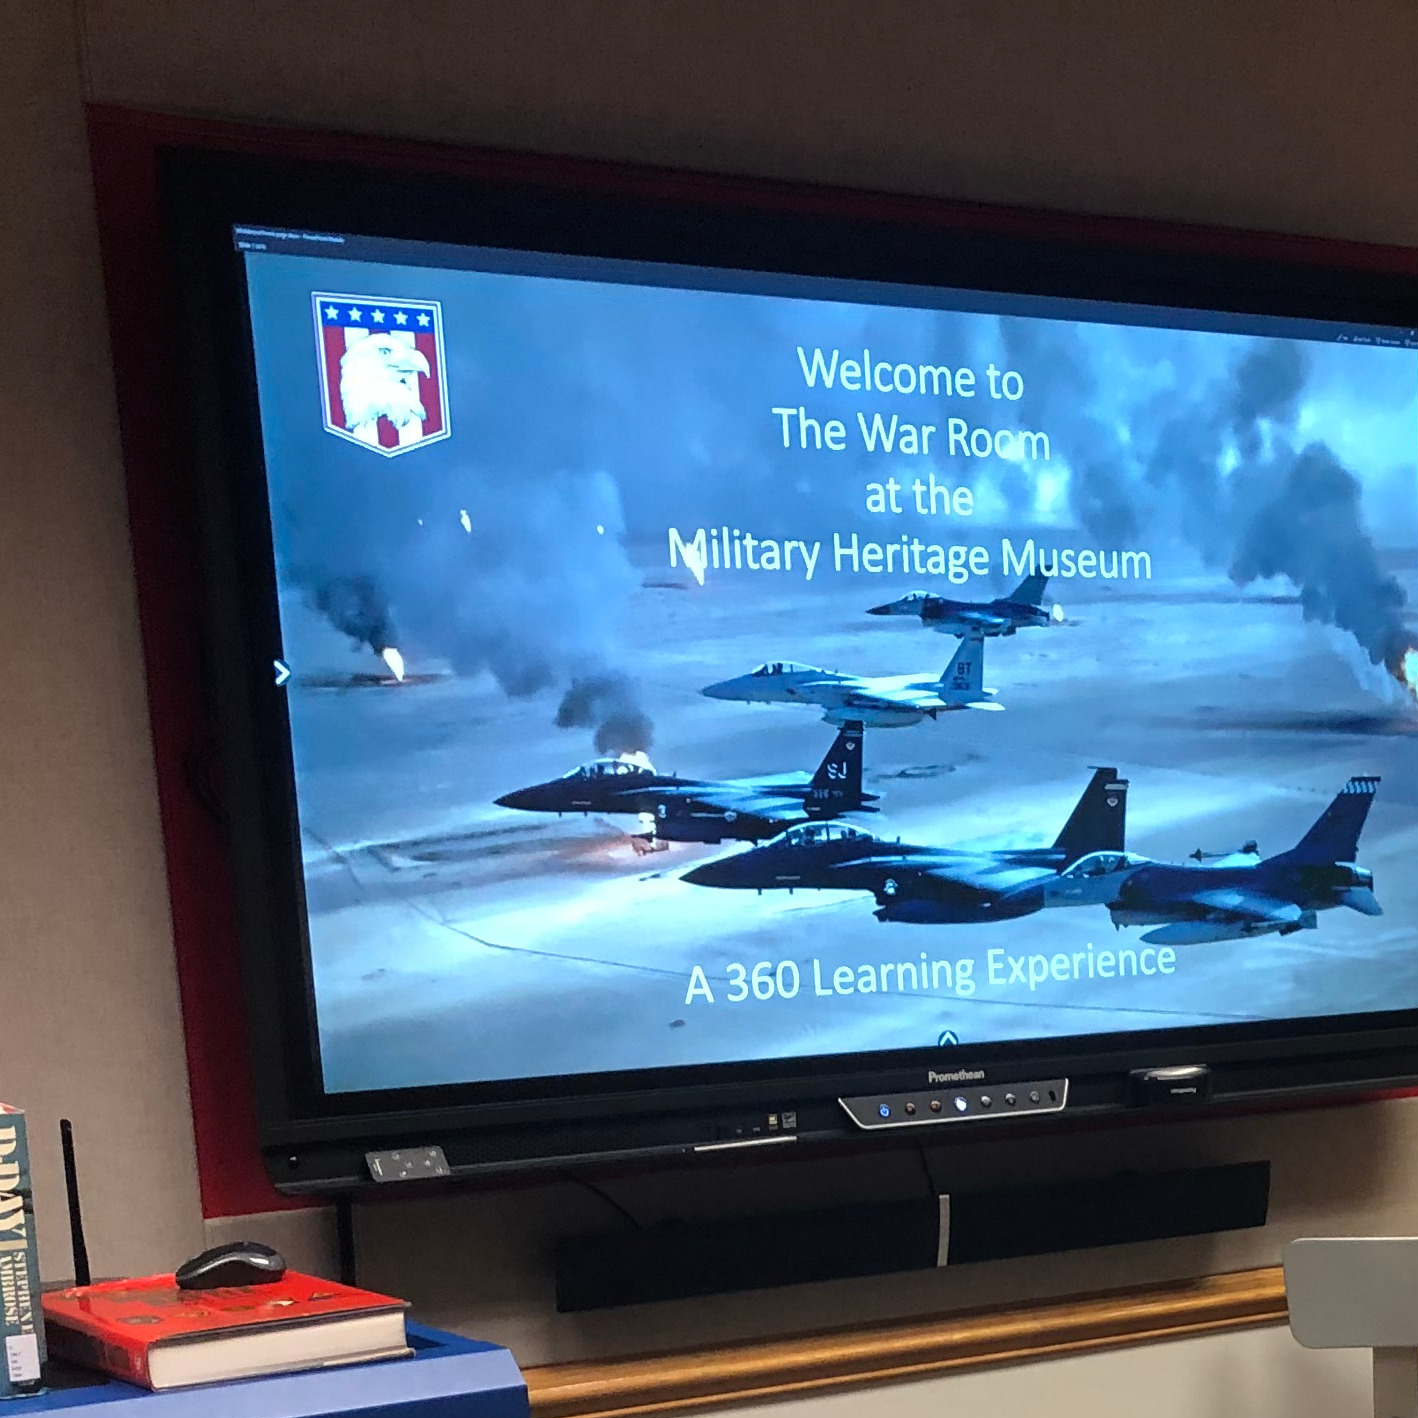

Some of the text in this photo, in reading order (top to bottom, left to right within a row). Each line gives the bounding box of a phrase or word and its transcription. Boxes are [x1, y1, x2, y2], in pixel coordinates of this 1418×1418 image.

[796, 346, 1024, 401] Welcome to
[772, 407, 1051, 461] The War Room
[866, 474, 974, 517] at the
[668, 526, 1152, 585] Military Heritage Museum
[685, 943, 1176, 1004] A 360 Learning Experience
[928, 1068, 984, 1083] Promethean
